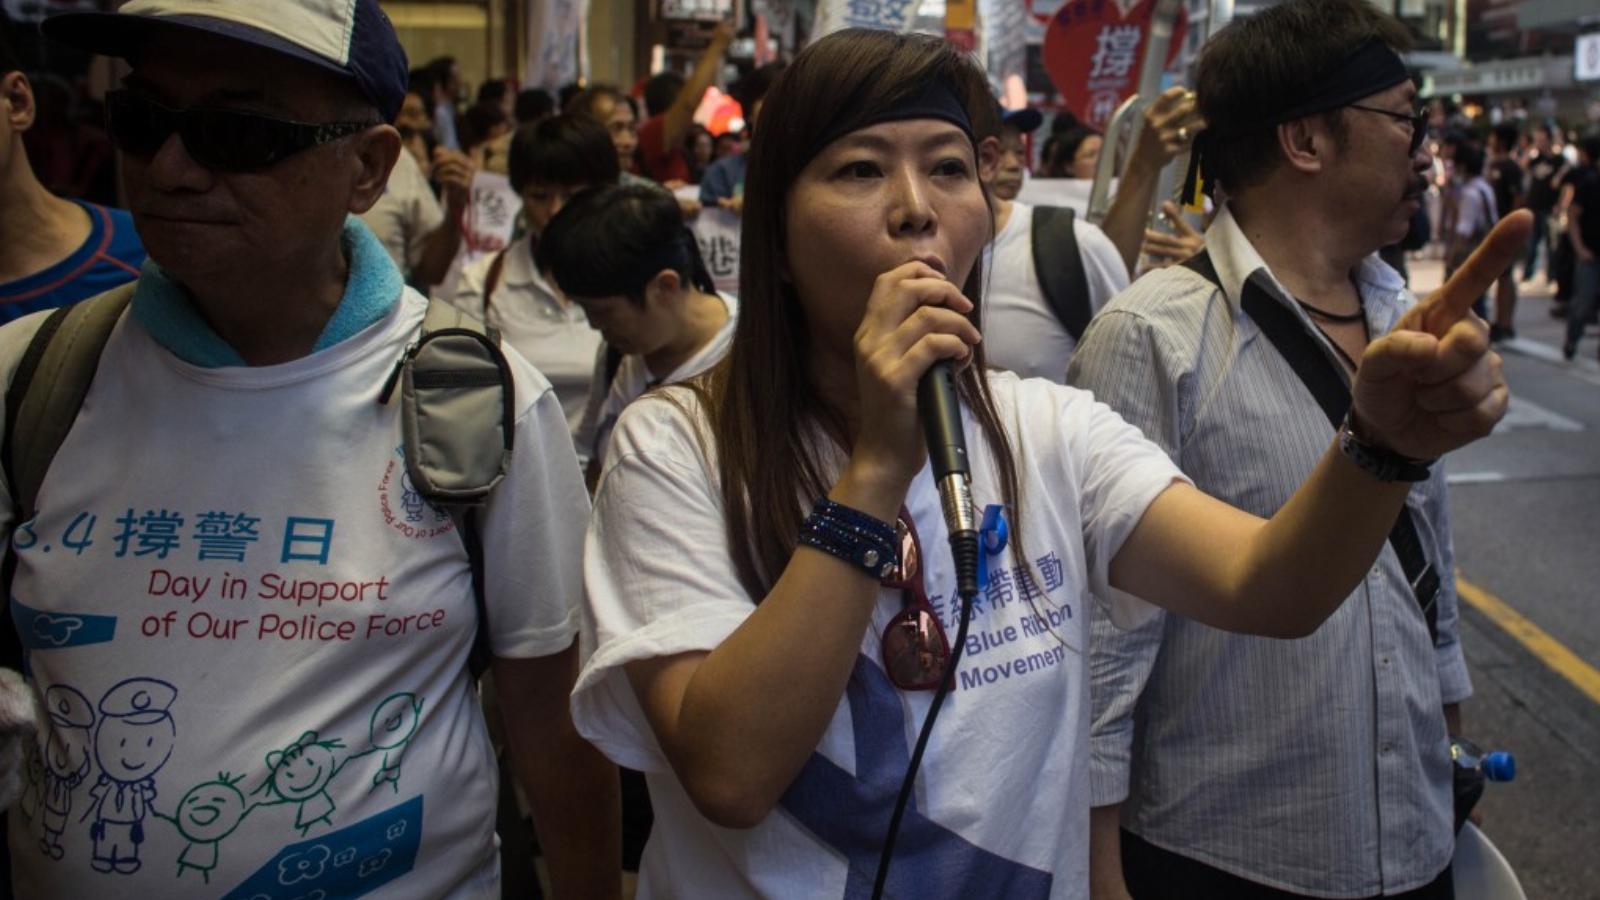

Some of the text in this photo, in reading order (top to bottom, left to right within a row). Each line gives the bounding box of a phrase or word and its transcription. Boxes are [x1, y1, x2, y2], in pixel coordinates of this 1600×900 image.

[113, 508, 335, 565] 撐警日
[148, 569, 390, 606] Day in Support
[141, 607, 446, 642] of Our Police Force
[964, 624, 1018, 657] Blue
